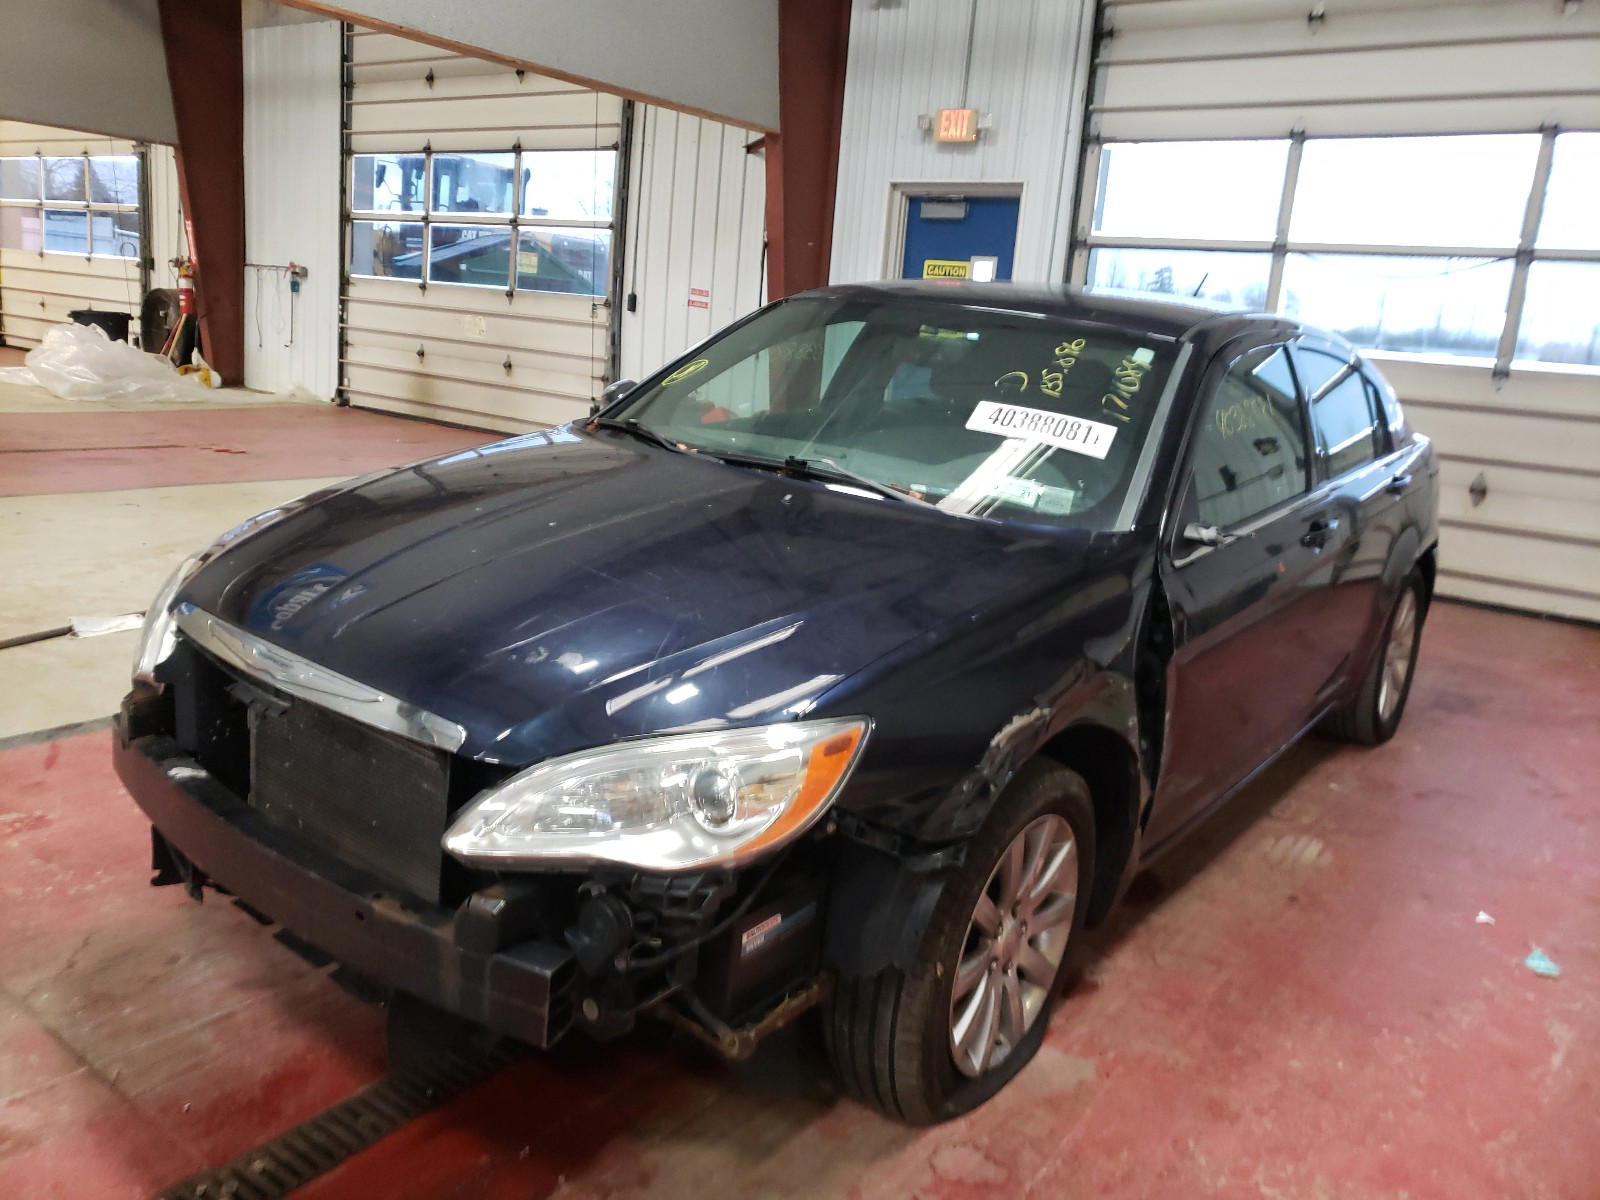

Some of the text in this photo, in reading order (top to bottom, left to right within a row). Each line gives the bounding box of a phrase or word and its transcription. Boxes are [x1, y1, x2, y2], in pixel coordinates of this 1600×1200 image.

[939, 109, 972, 139] EXIT
[927, 263, 967, 278] CAUTION
[988, 407, 1094, 445] 40388081
